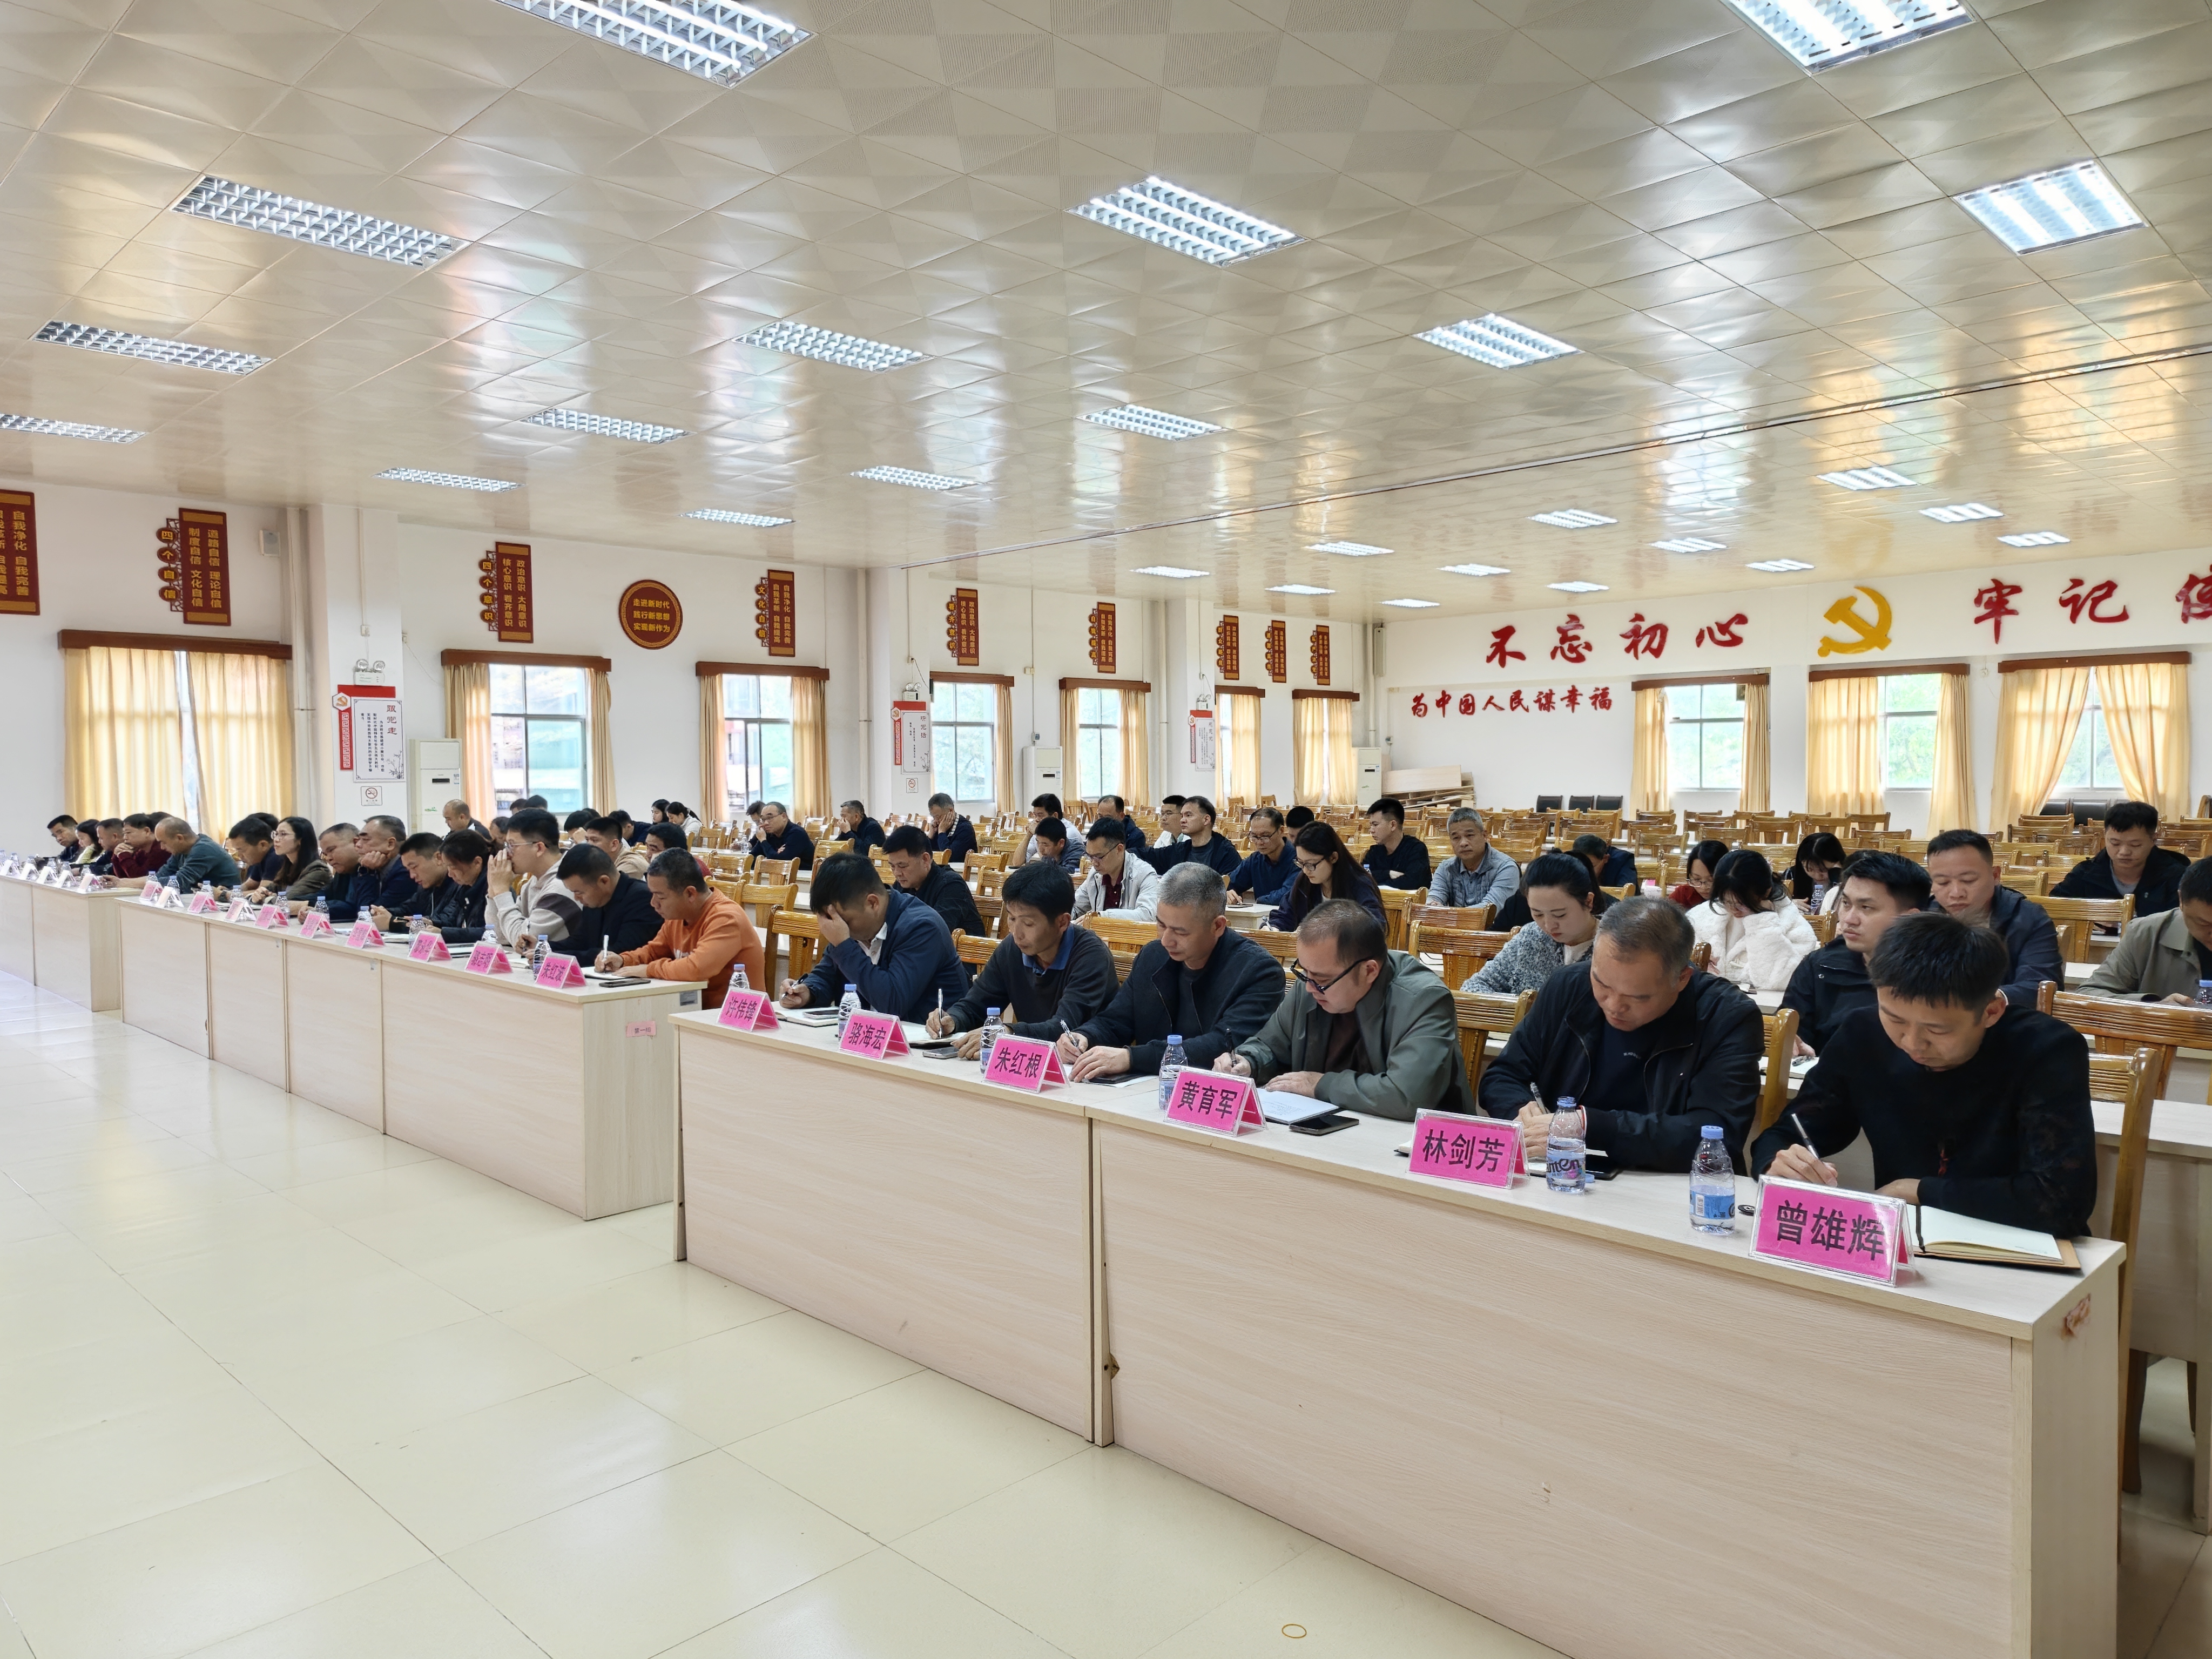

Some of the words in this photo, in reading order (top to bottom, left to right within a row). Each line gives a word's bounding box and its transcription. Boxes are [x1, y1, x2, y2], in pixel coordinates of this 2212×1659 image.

[161, 530, 176, 599] 四个自信
[188, 528, 201, 565] 制度自信
[207, 529, 220, 567] 道路自信
[191, 570, 203, 607] 文化自信
[209, 571, 222, 608] 理论自信
[482, 562, 494, 621] 四个意识
[502, 558, 512, 591] 核心意识
[516, 560, 526, 592] 政治意识
[633, 599, 670, 609] 走进新时代
[633, 611, 670, 621] 践行新思想
[633, 623, 670, 632] 实现新作为
[1486, 612, 1749, 668] 不忘初心
[1411, 685, 1613, 718] 为中国人民谋幸福
[848, 1022, 887, 1050] 骆海宏
[994, 1047, 1042, 1078] 朱红根
[1177, 1081, 1238, 1118] 黄育军
[1422, 1129, 1505, 1172] 林剑芳
[1777, 1199, 1884, 1261] 曾雄辉
